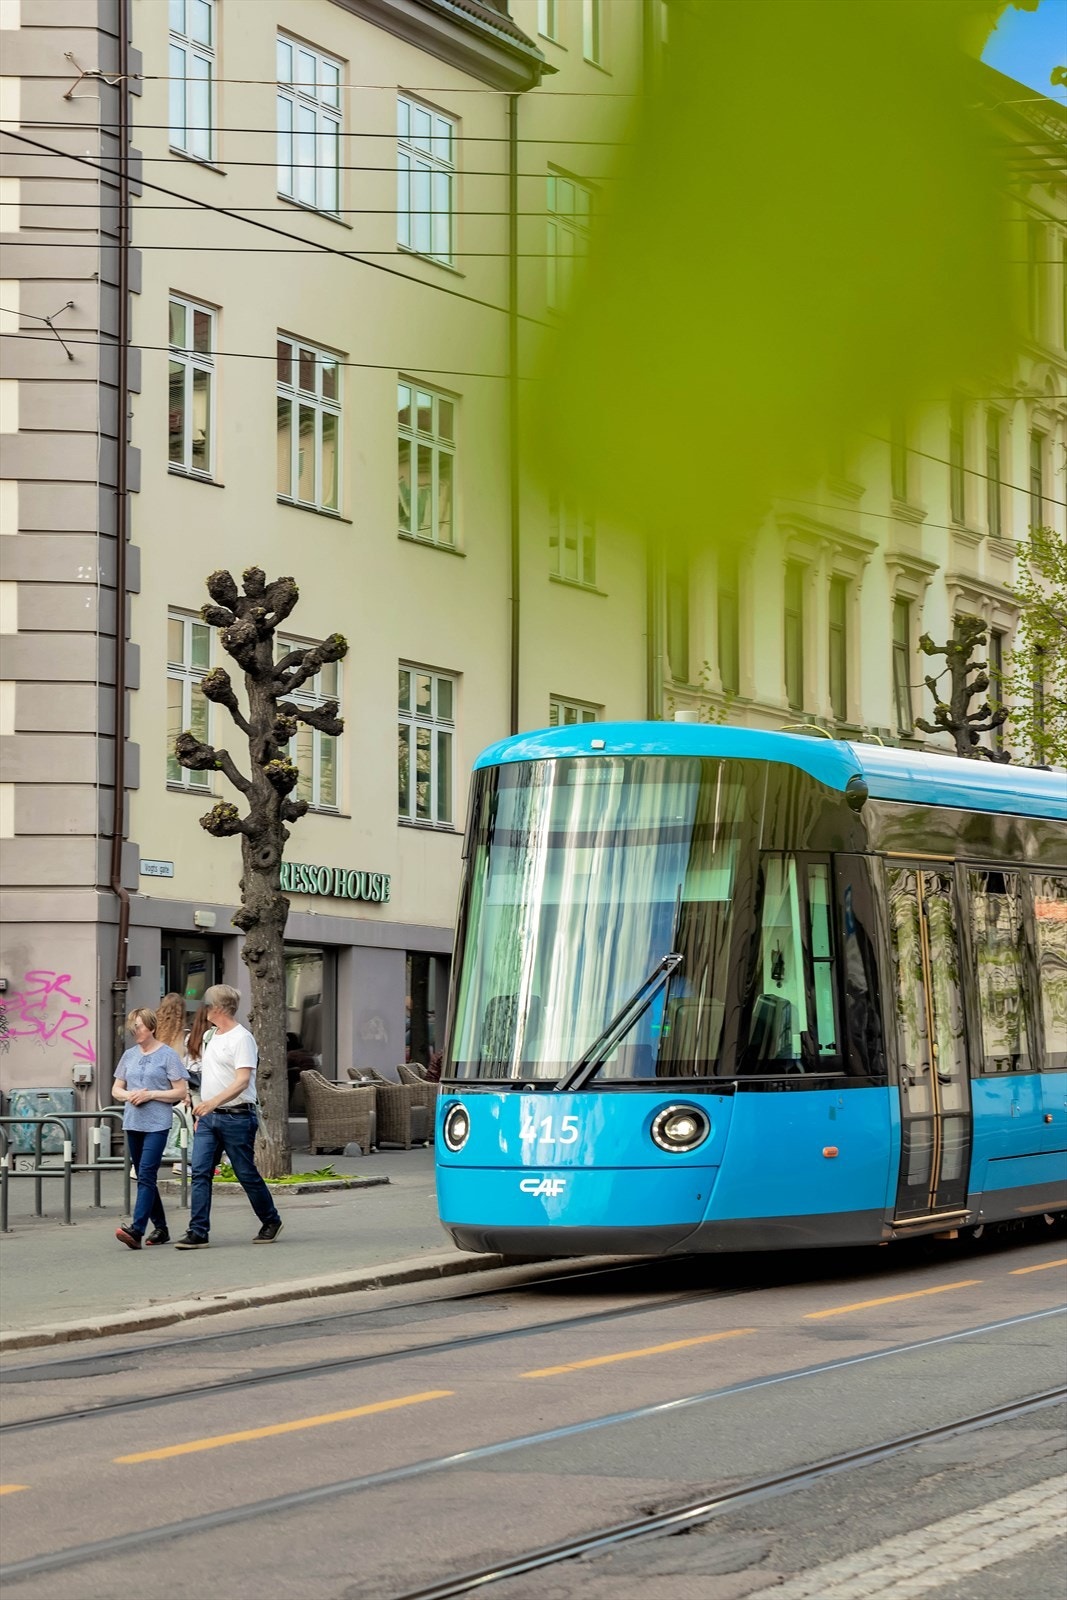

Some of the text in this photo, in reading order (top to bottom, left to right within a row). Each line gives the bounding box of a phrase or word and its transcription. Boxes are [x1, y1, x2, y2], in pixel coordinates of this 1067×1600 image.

[160, 866, 170, 875] gate
[280, 861, 391, 904] RESSO HOUSE
[519, 1115, 579, 1144] 415
[520, 1178, 567, 1197] CAF
